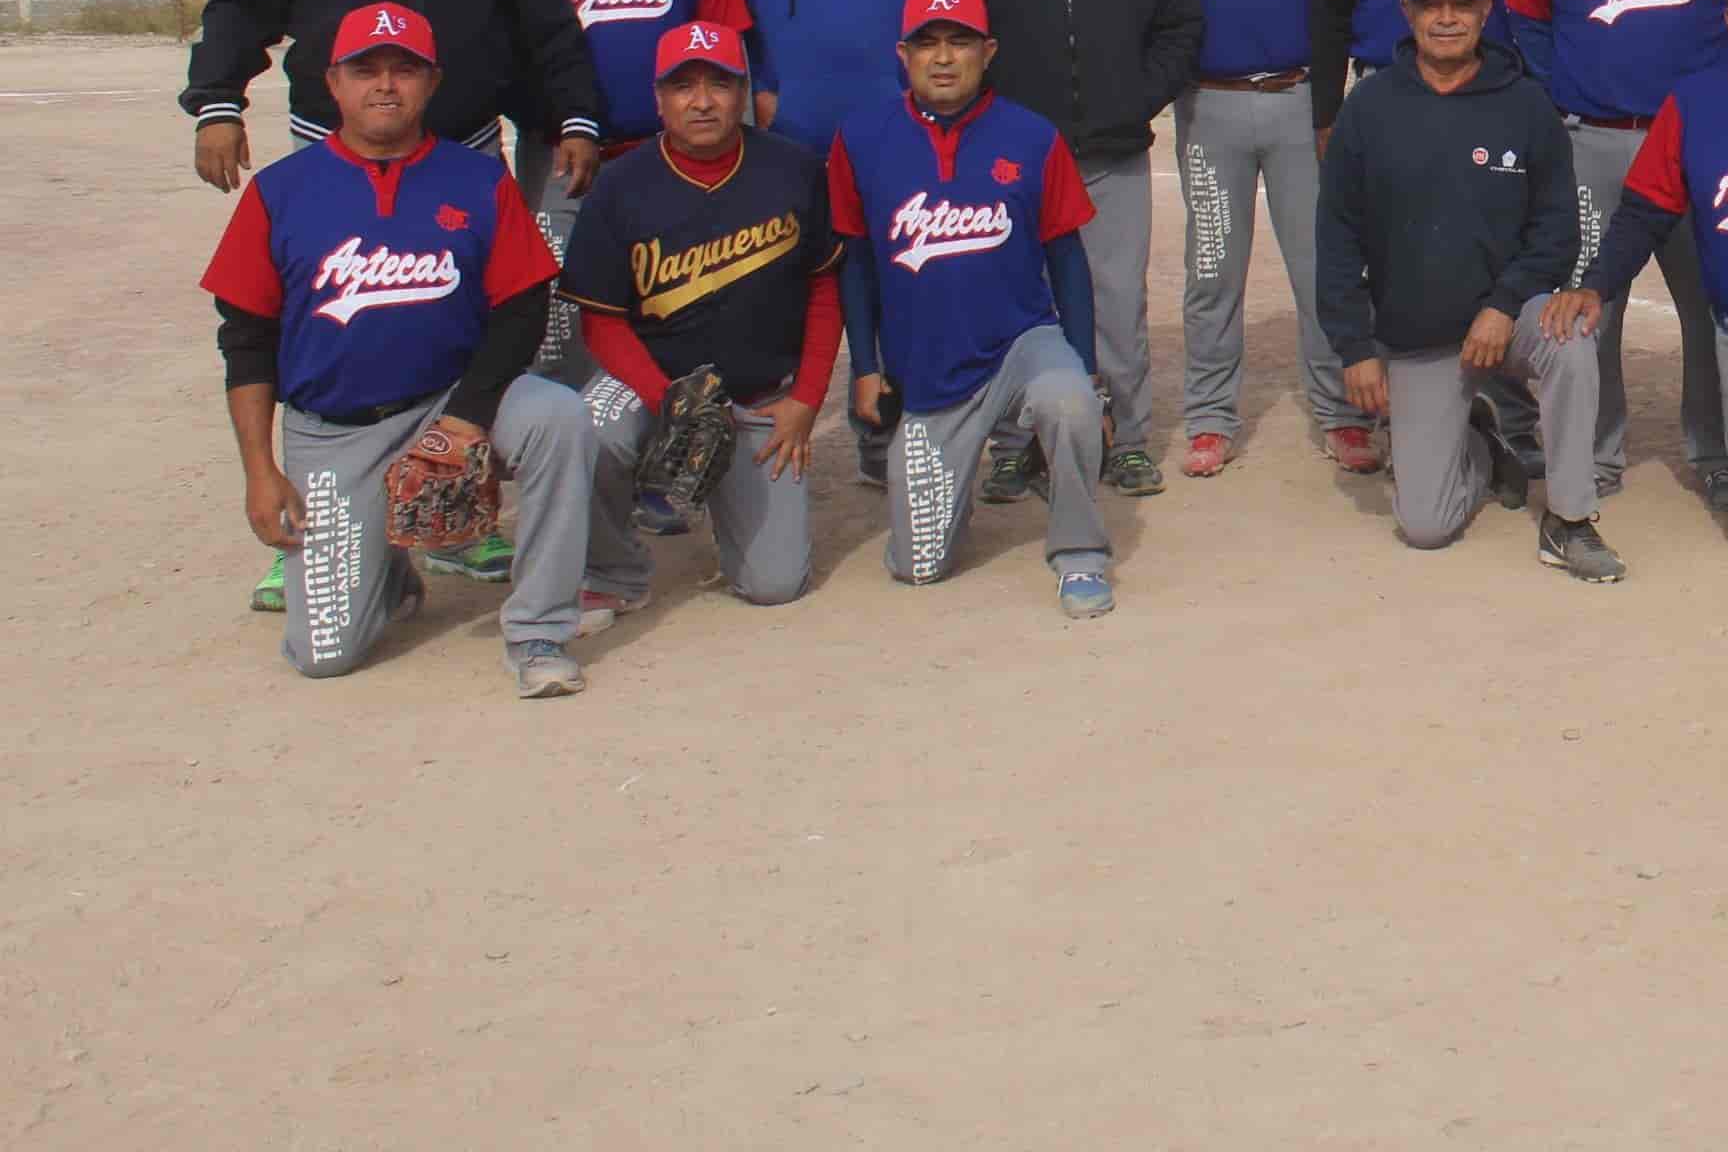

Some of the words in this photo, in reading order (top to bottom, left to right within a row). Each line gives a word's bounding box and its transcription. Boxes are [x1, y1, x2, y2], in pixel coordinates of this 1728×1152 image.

[369, 10, 406, 36] A's
[683, 25, 719, 50] A's
[631, 208, 801, 320] Vaqueros
[891, 191, 1013, 273] Aztecas
[313, 236, 461, 325] Aztecas
[334, 496, 351, 627] GUADALUPE
[350, 520, 364, 588] ORIENTE
